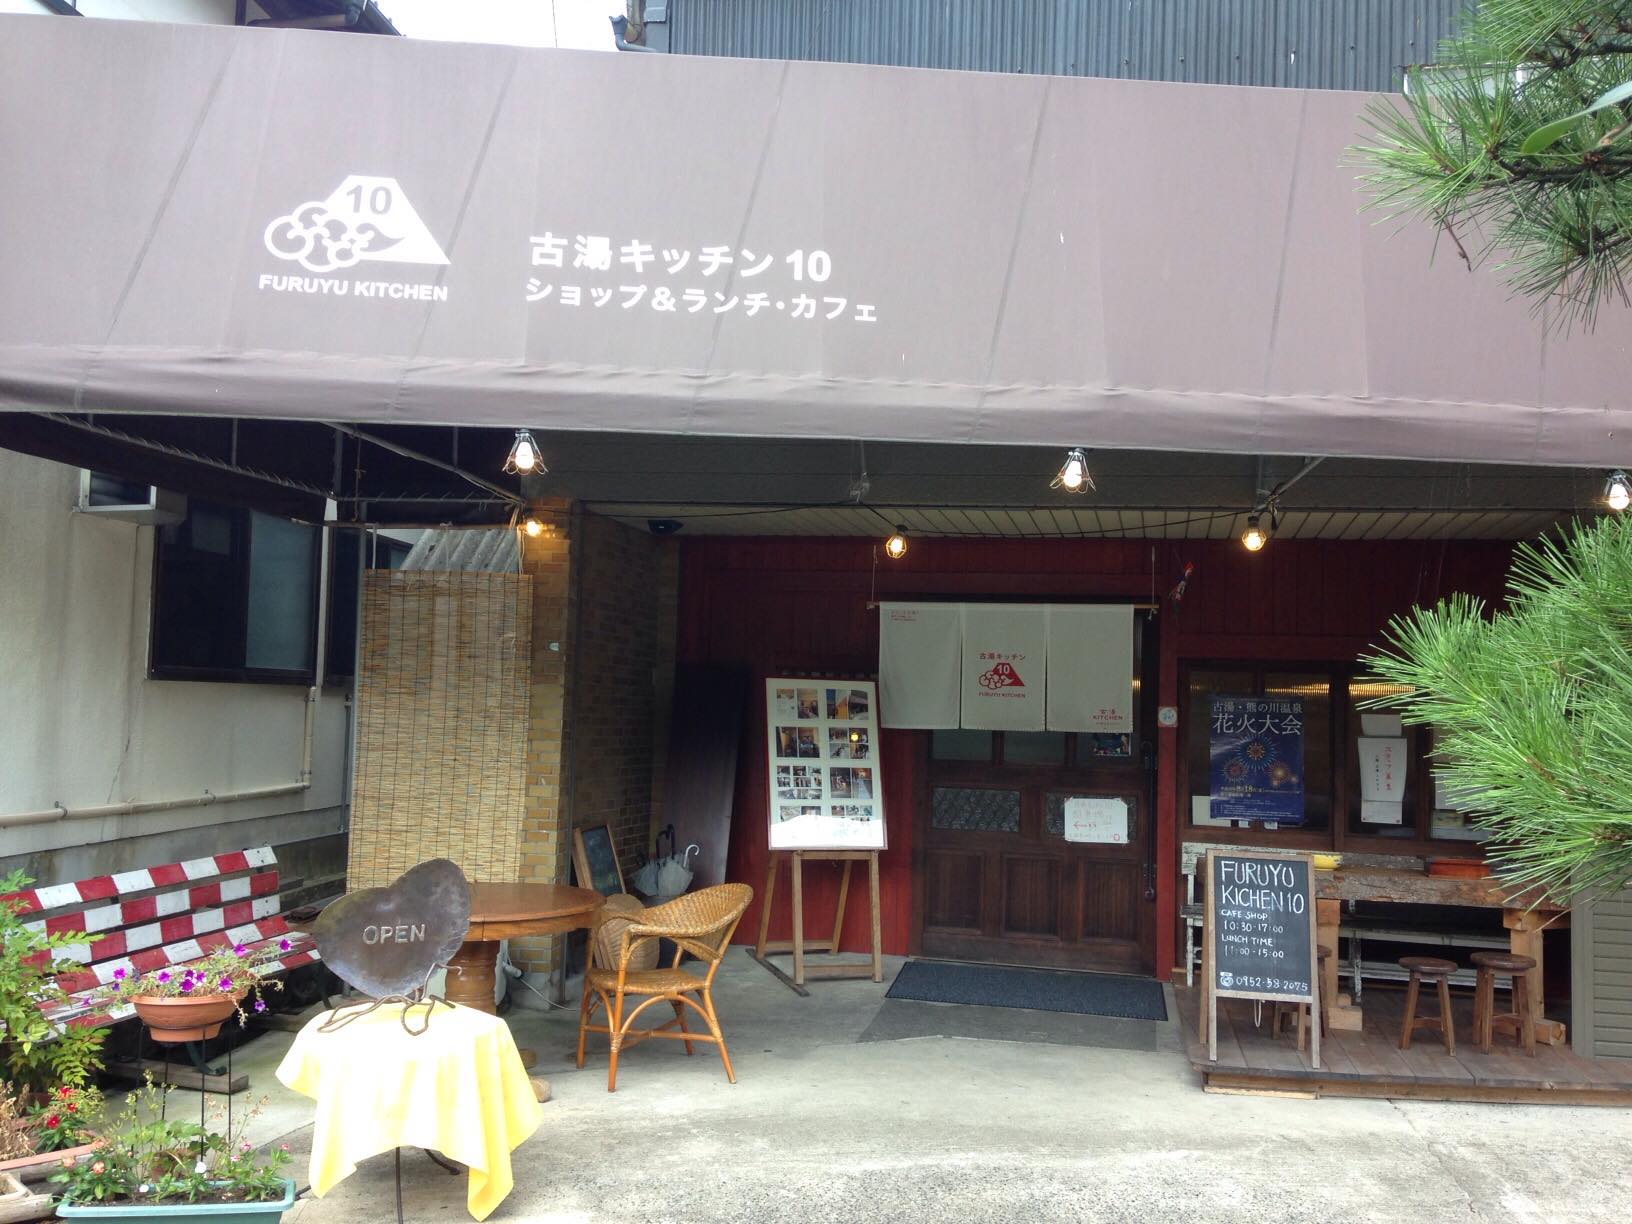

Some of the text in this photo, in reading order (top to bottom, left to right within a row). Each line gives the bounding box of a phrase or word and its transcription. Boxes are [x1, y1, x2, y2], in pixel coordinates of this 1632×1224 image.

[346, 184, 393, 215] 10
[529, 231, 833, 282] 古湯キッチン 10
[258, 274, 448, 301] FURUYU KITCHEN
[996, 664, 1010, 674] 10
[1212, 713, 1303, 735] 花火大会
[1221, 860, 1294, 888] FURUYU
[1221, 885, 1305, 915] KICHEN 10
[1220, 909, 1269, 921] CAFE SHOP
[362, 923, 426, 945] OPEN
[1221, 933, 1274, 947] LUNCH TIME
